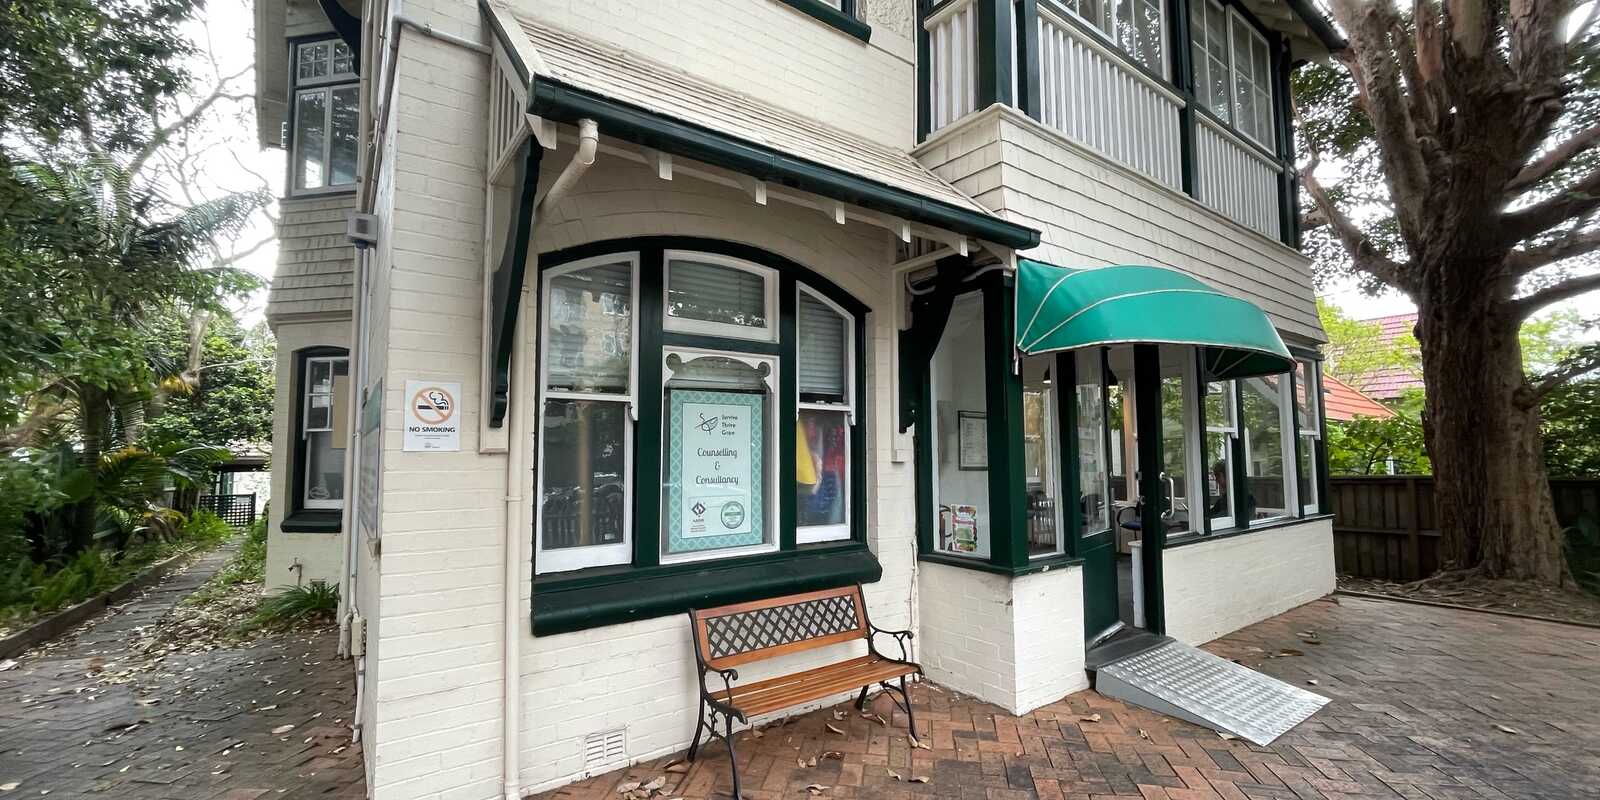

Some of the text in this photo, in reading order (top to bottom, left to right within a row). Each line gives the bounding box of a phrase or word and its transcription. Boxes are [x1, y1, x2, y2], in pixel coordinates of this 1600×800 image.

[697, 447, 738, 459] Counselling
[714, 461, 720, 470] &
[696, 475, 739, 486] Consultancy
